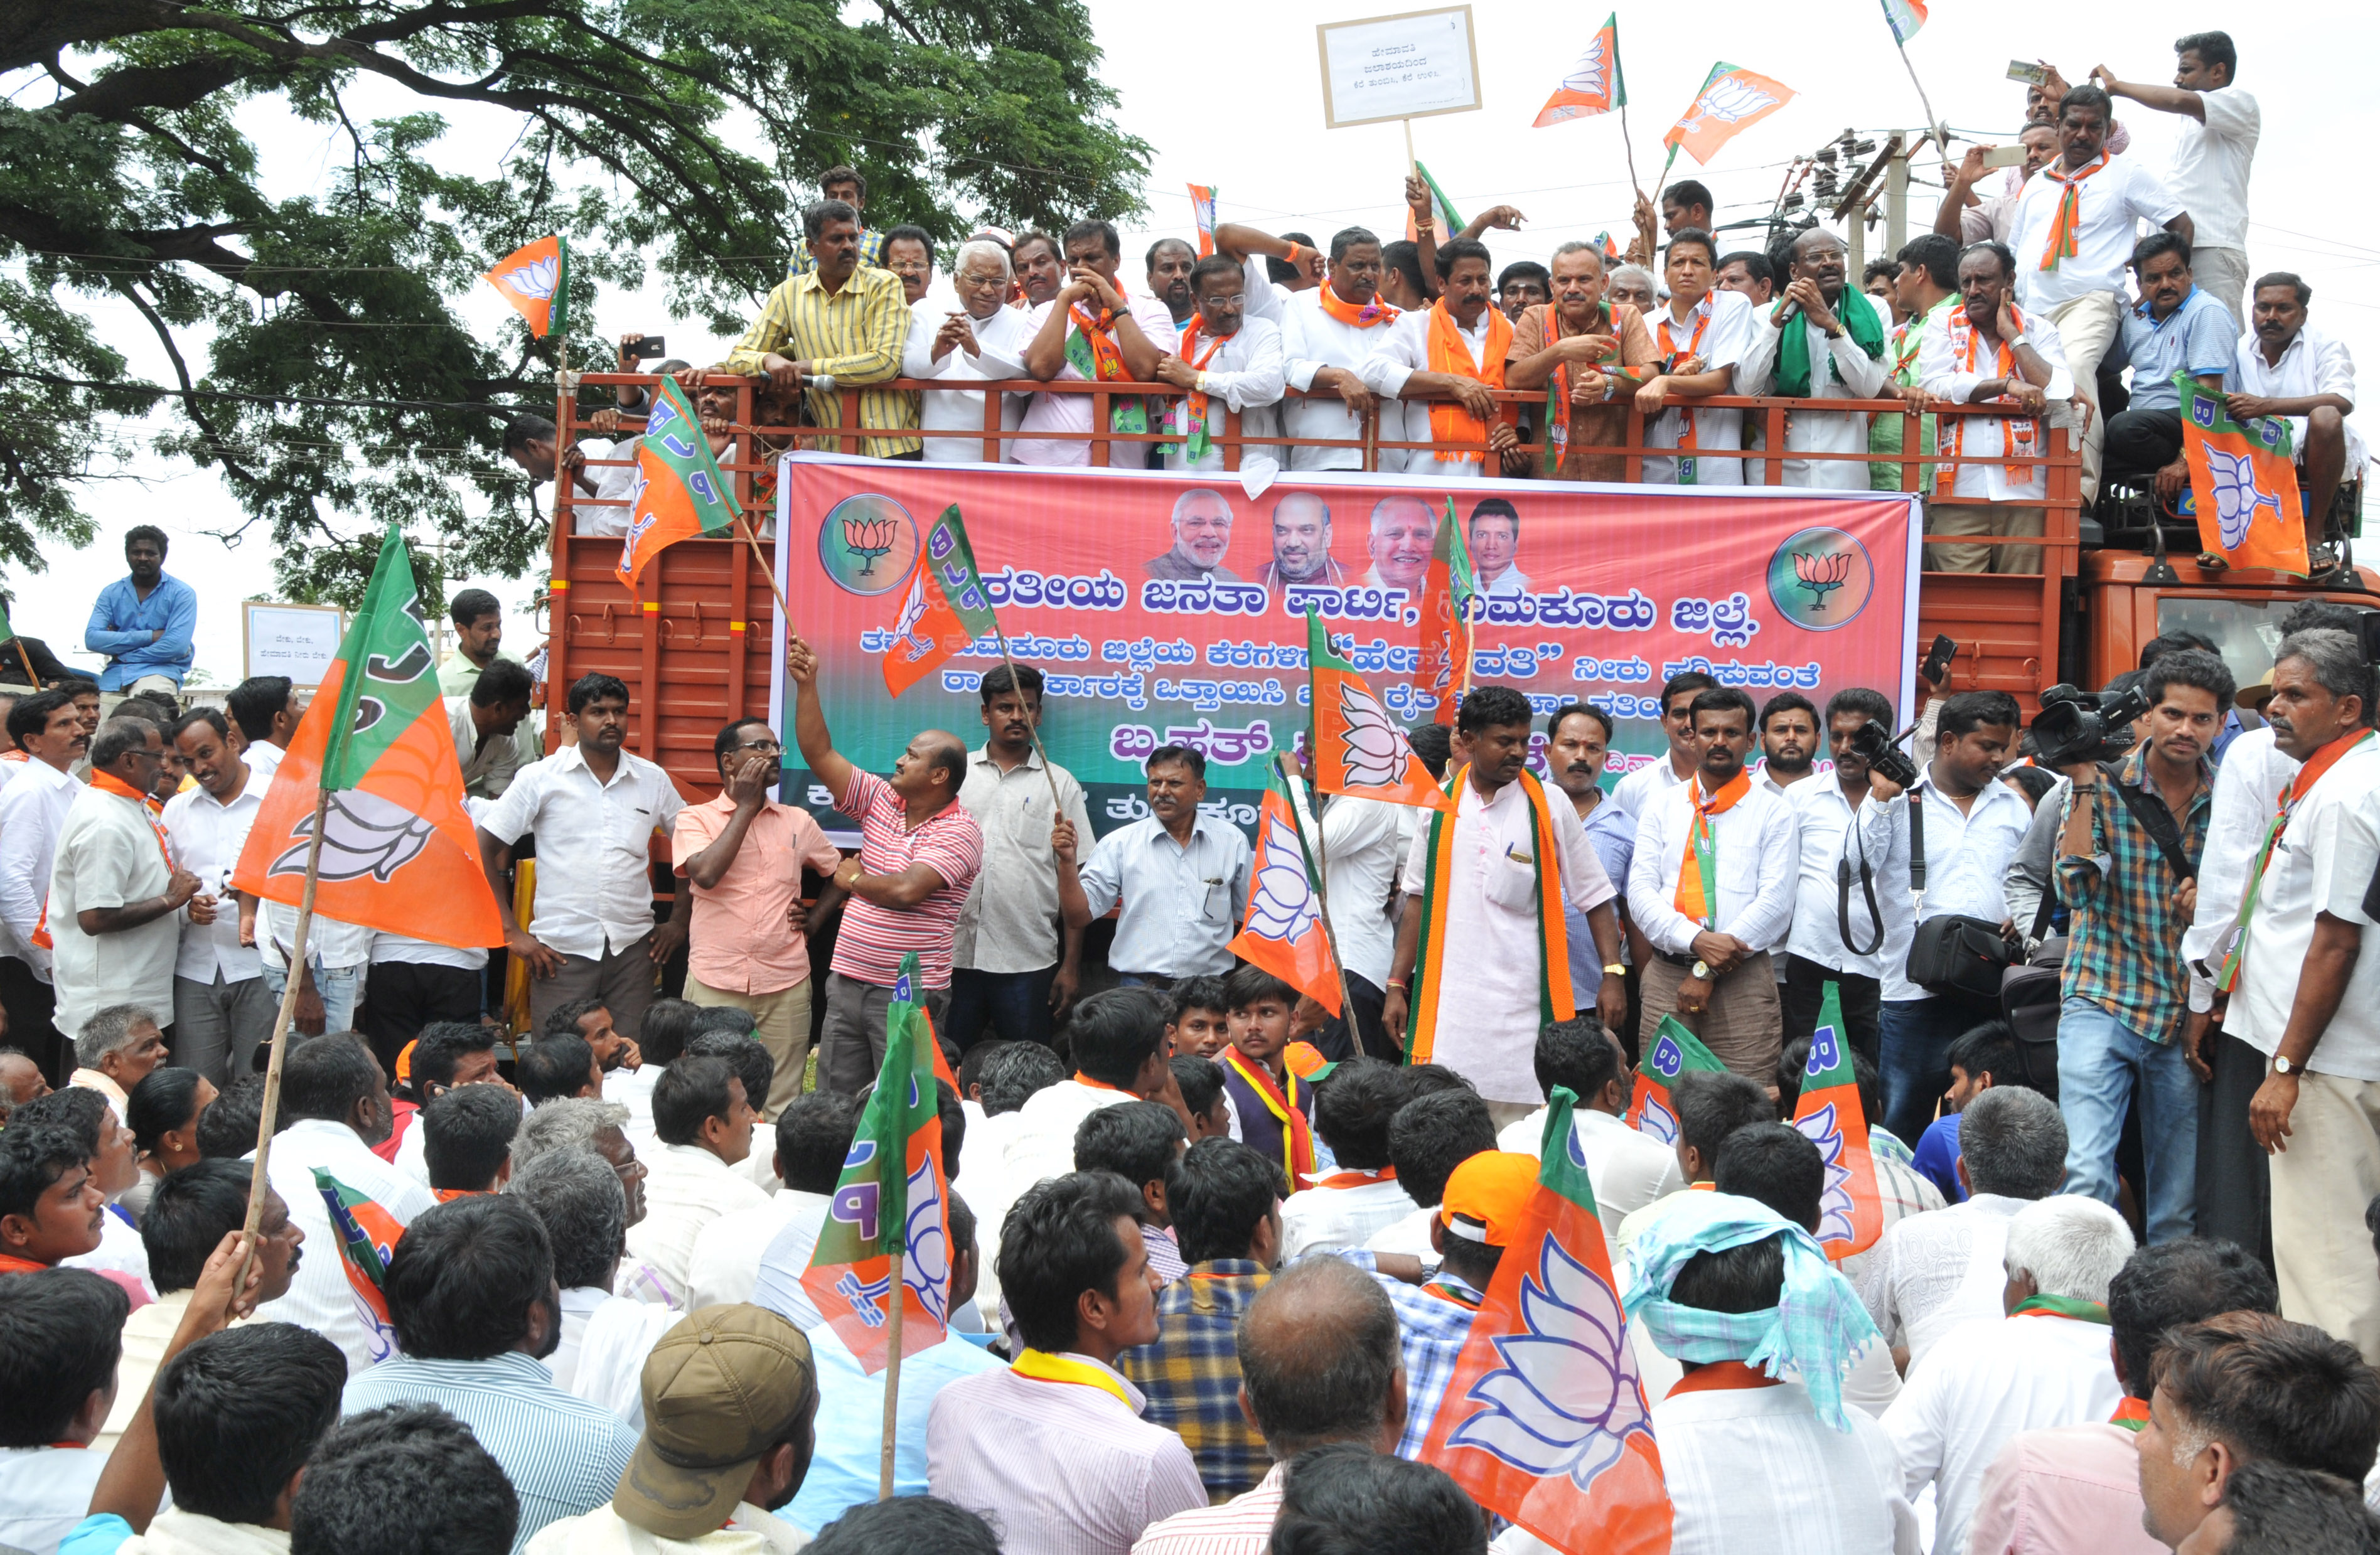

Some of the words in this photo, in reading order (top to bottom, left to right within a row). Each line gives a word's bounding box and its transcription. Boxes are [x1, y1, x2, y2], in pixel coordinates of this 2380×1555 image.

[1371, 43, 1416, 57] ಹೇಮಾವತಿ
[1364, 57, 1427, 73] ಜಲಾಶಯದಿಂದ
[1354, 80, 1364, 89] ಕೆರೆ
[1402, 73, 1413, 82] ಕೆರೆ
[1142, 574, 1267, 612] ಜನತಾ
[1102, 636, 1196, 672] ಜಿಲ್ಲೆಯ
[1572, 655, 1652, 683] ನೀರು
[1662, 656, 1821, 689] ಹರಿಸುವಂತೆ
[1154, 678, 1286, 710] ಒತ್ತಾಯಿಸಿ
